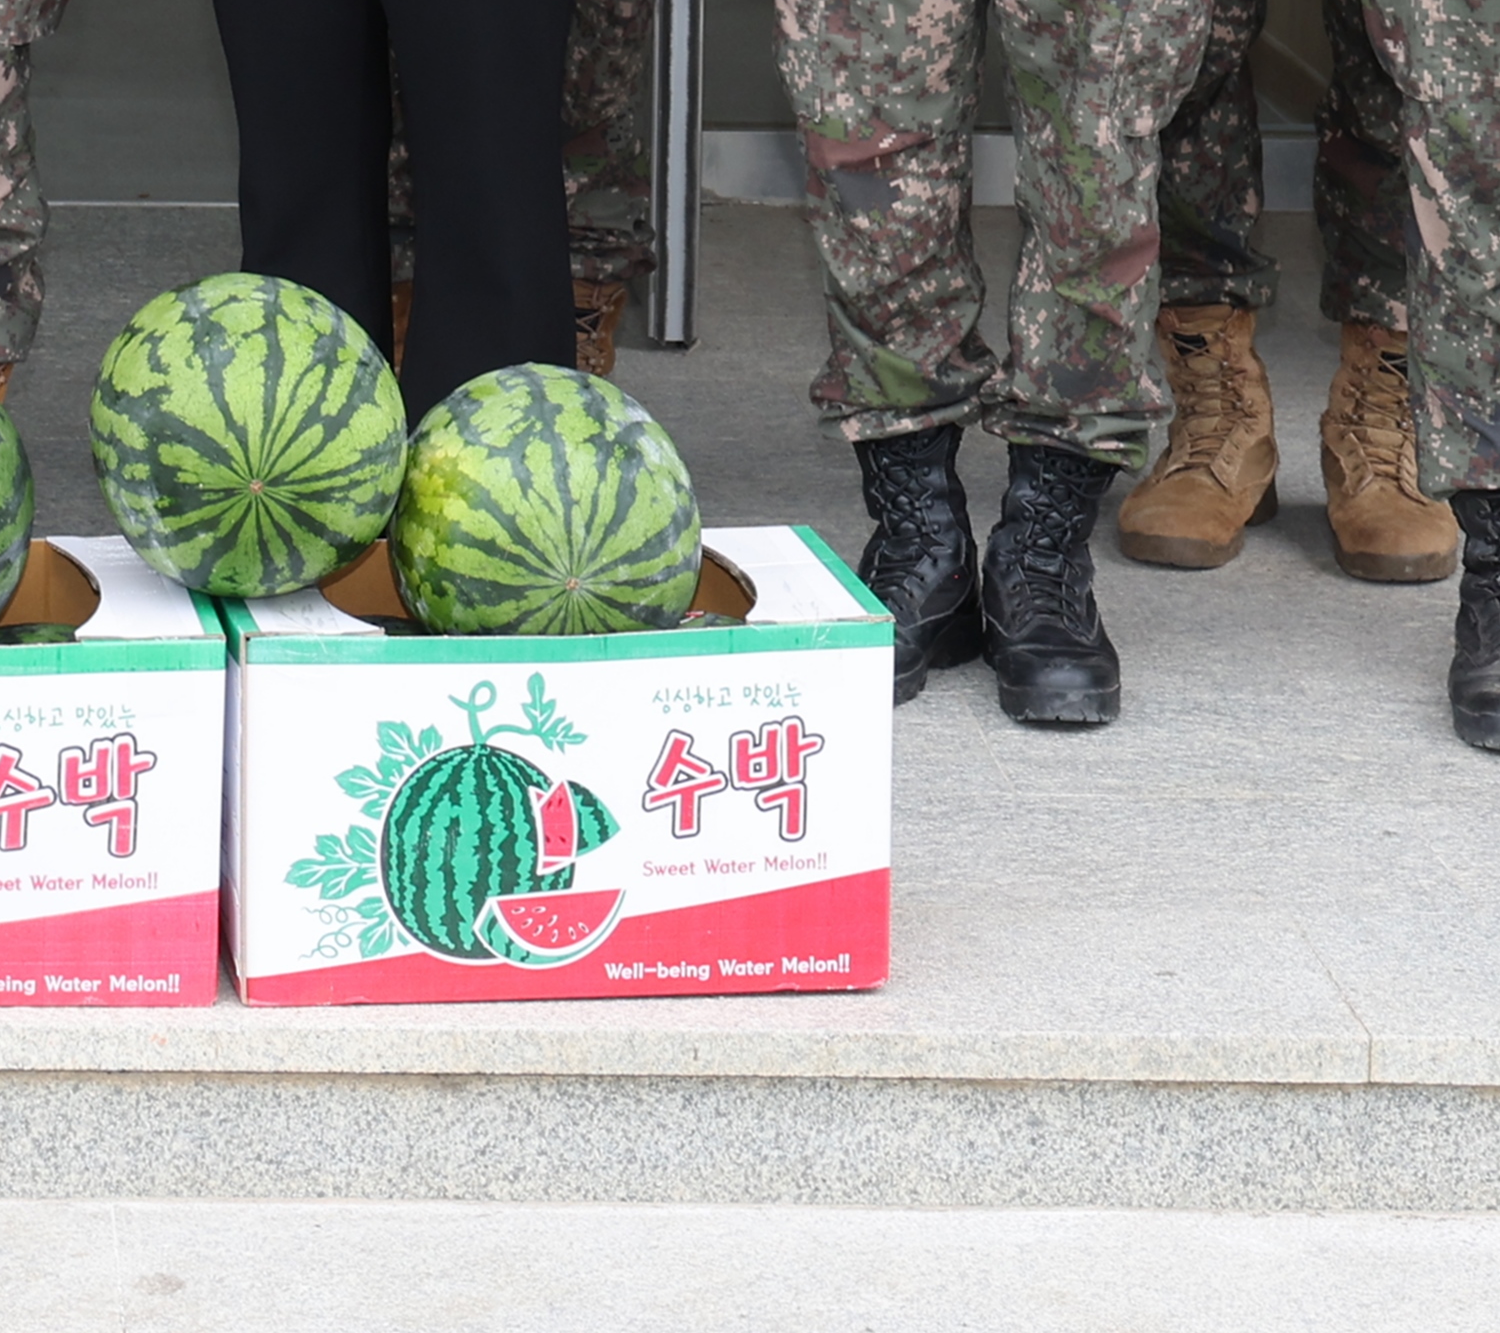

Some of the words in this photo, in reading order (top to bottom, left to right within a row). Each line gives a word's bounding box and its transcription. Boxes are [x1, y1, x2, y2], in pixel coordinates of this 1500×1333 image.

[651, 683, 734, 713] 싱싱하고
[741, 682, 803, 710] 맛있는
[73, 703, 137, 731] 맛있는
[643, 716, 824, 842] 수박
[642, 859, 698, 878] Sweet
[703, 856, 758, 875] Water
[763, 852, 829, 872] Melon!!
[29, 874, 84, 891] Water
[91, 871, 159, 891] Melon!!
[604, 960, 711, 982] Well-being
[717, 958, 775, 977] Water
[781, 953, 851, 975] Melon!!
[43, 974, 101, 993] Water
[109, 973, 181, 994] Melon!!
